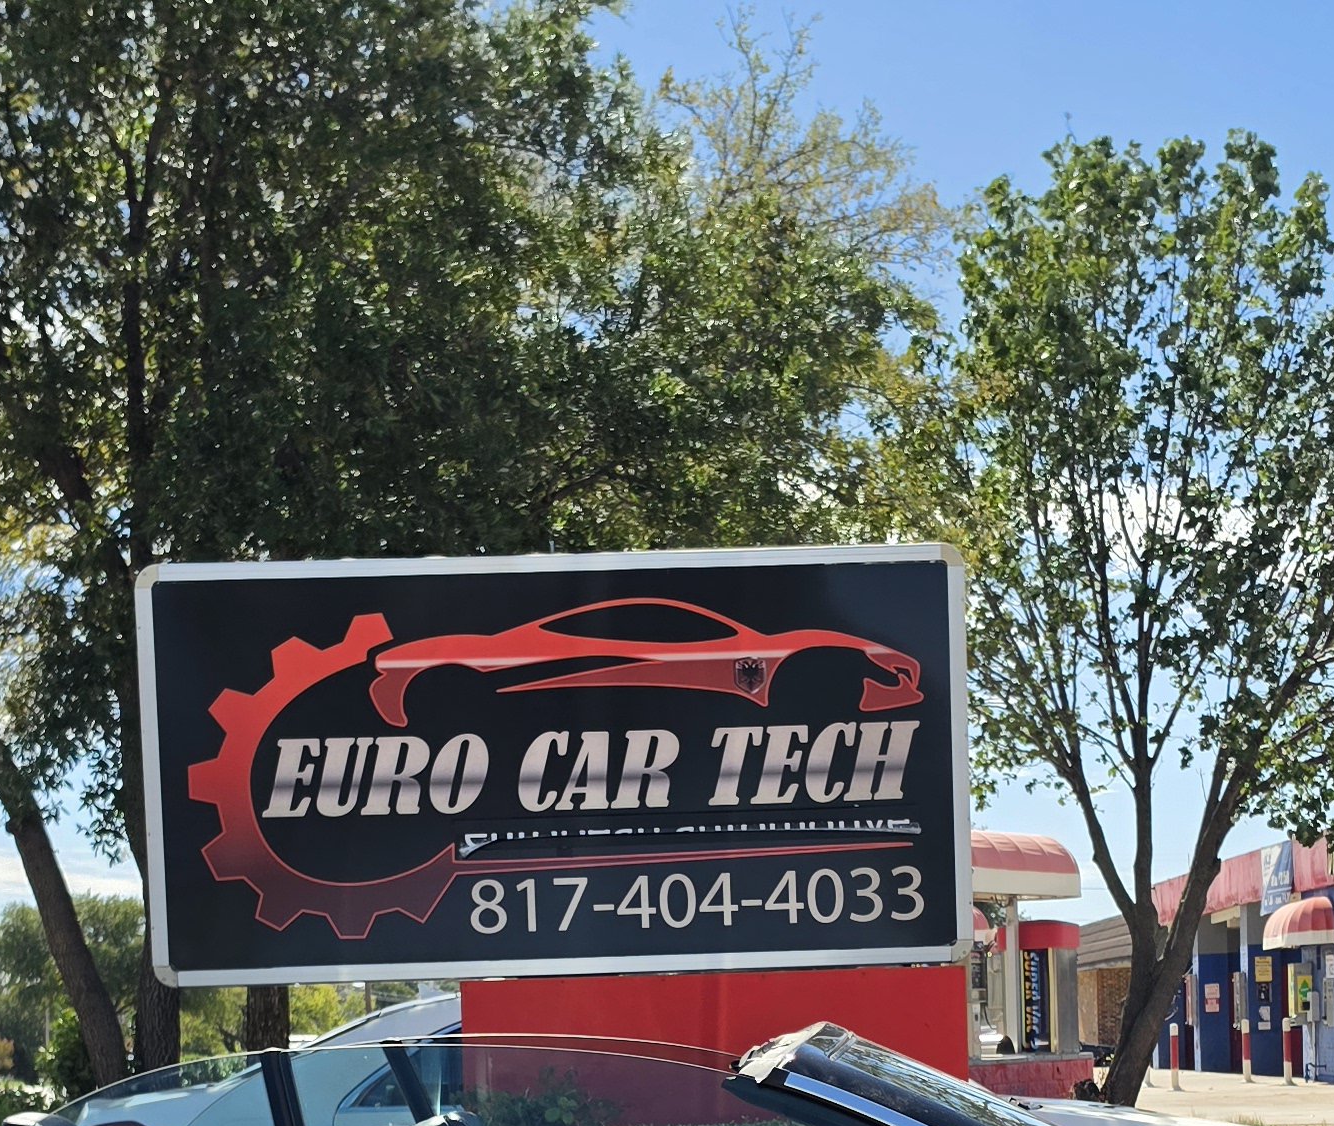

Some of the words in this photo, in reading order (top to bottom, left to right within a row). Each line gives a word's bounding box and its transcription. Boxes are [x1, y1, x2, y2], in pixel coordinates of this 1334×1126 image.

[262, 733, 490, 819] EURO
[519, 728, 682, 813] CAR
[708, 720, 920, 808] TECH
[470, 865, 925, 935] 817-404-4033
